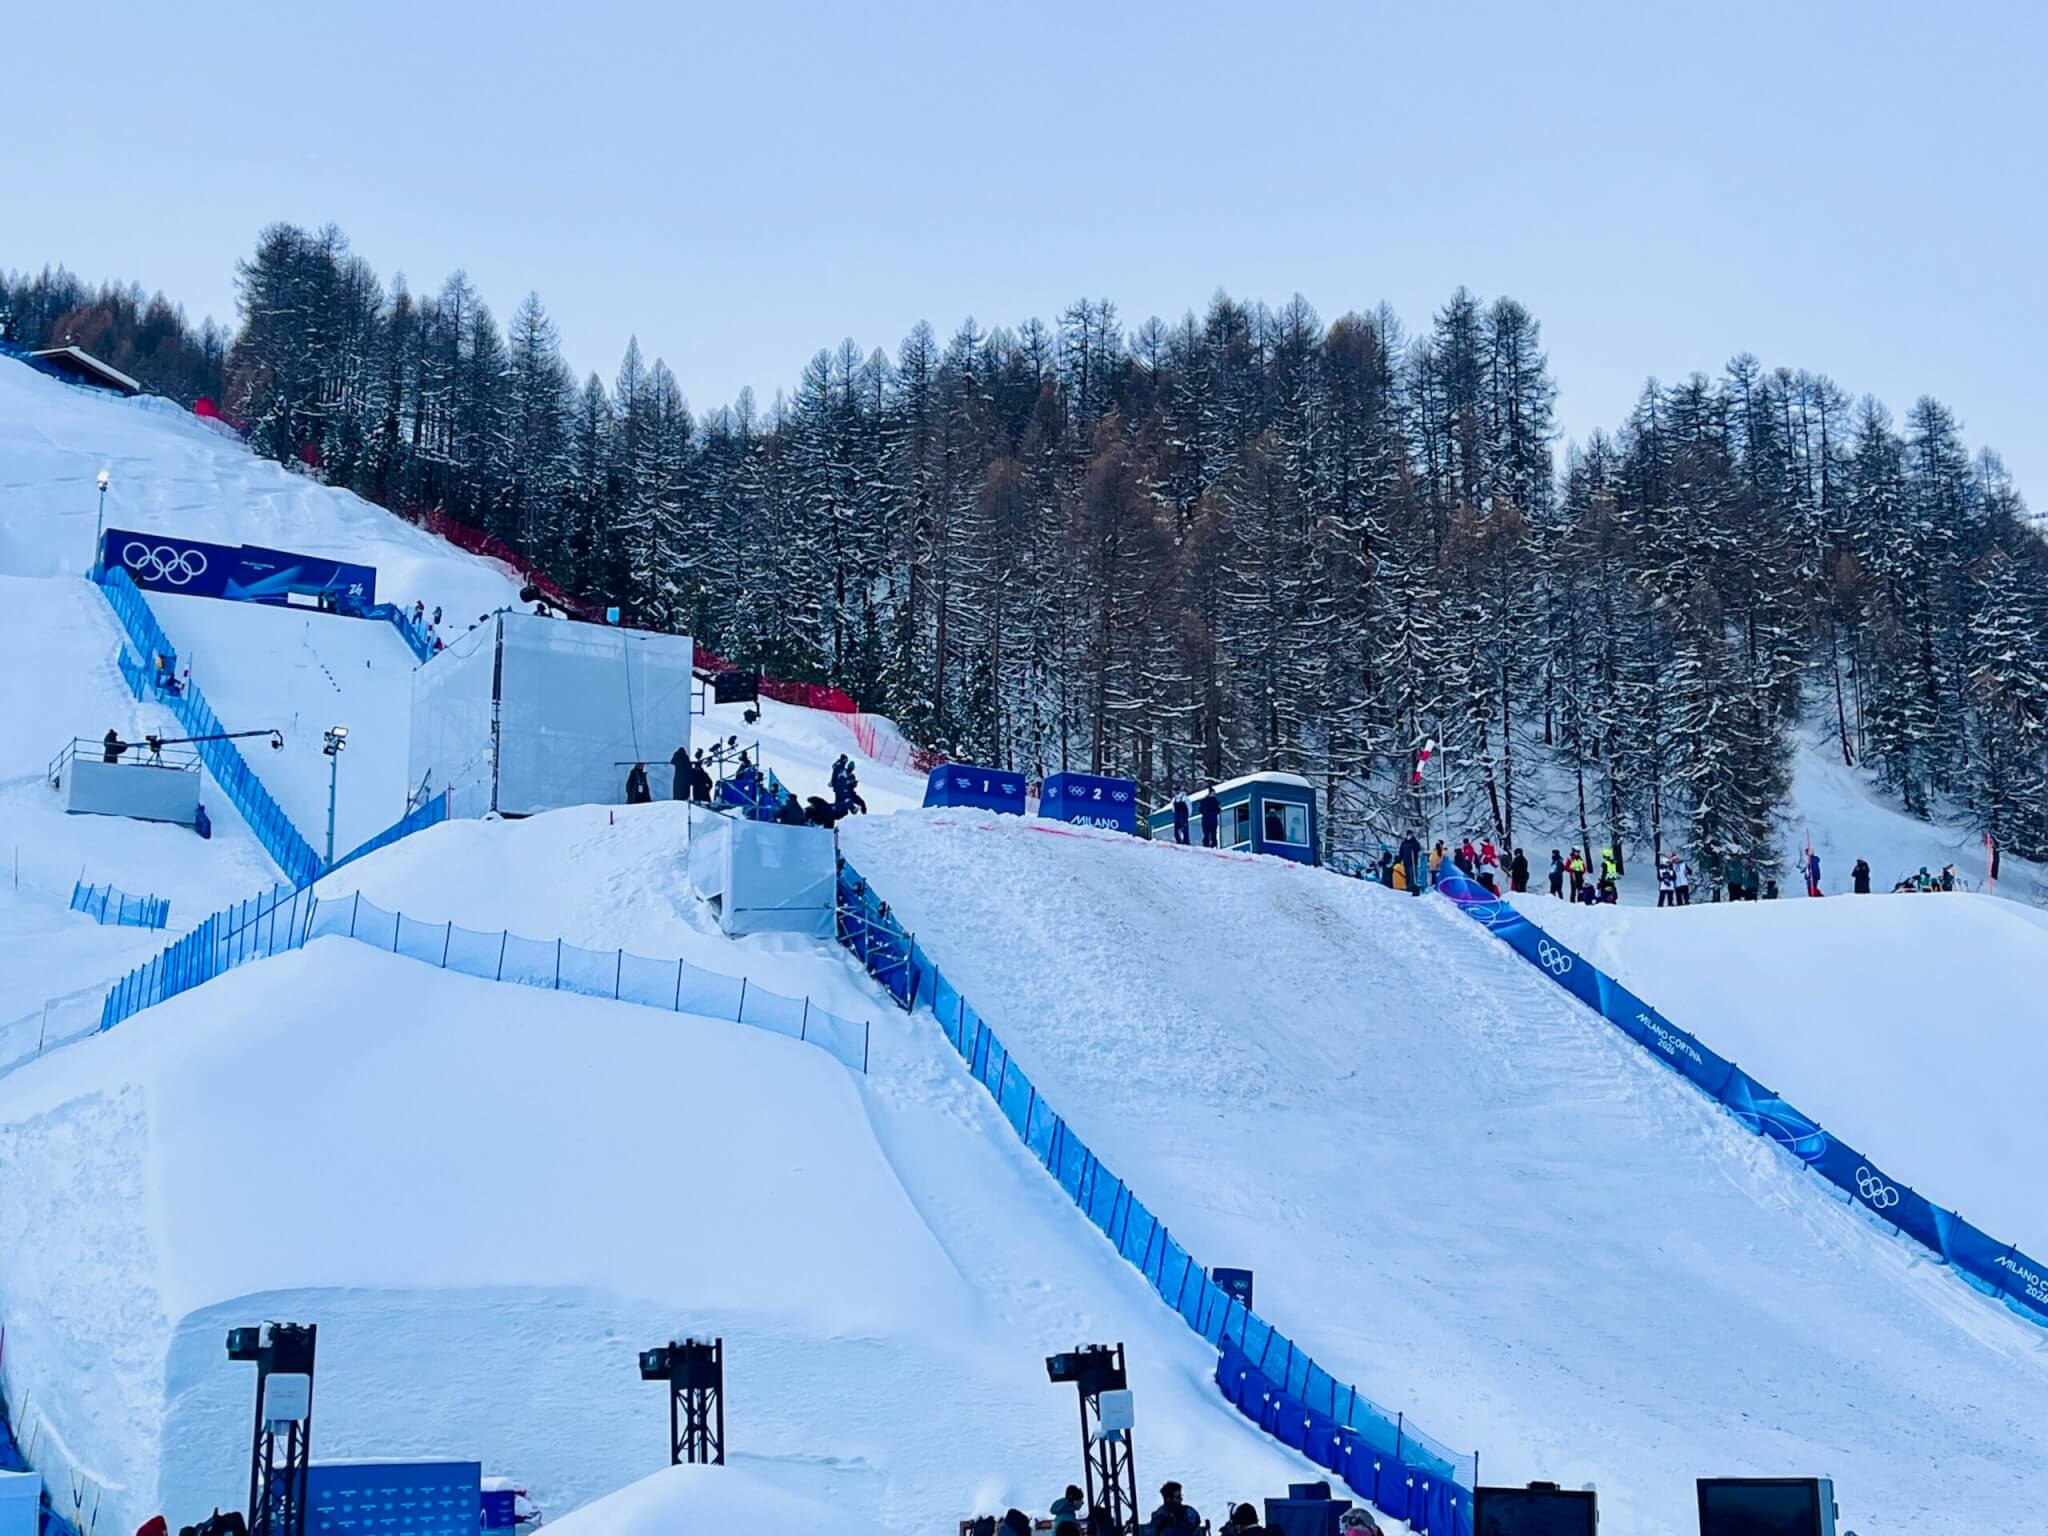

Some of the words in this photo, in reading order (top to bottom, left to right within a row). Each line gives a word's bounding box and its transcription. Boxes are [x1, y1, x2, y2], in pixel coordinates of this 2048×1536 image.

[983, 780, 990, 793] 1
[1092, 787, 1102, 800] 2
[1070, 815, 1120, 830] MILANO
[1635, 1013, 1669, 1040] MILANO
[1668, 1035, 1703, 1065] CORTINA
[1657, 1038, 1676, 1056] 2026
[1993, 1256, 2040, 1285] MILANO
[2025, 1284, 2048, 1304] 2026
